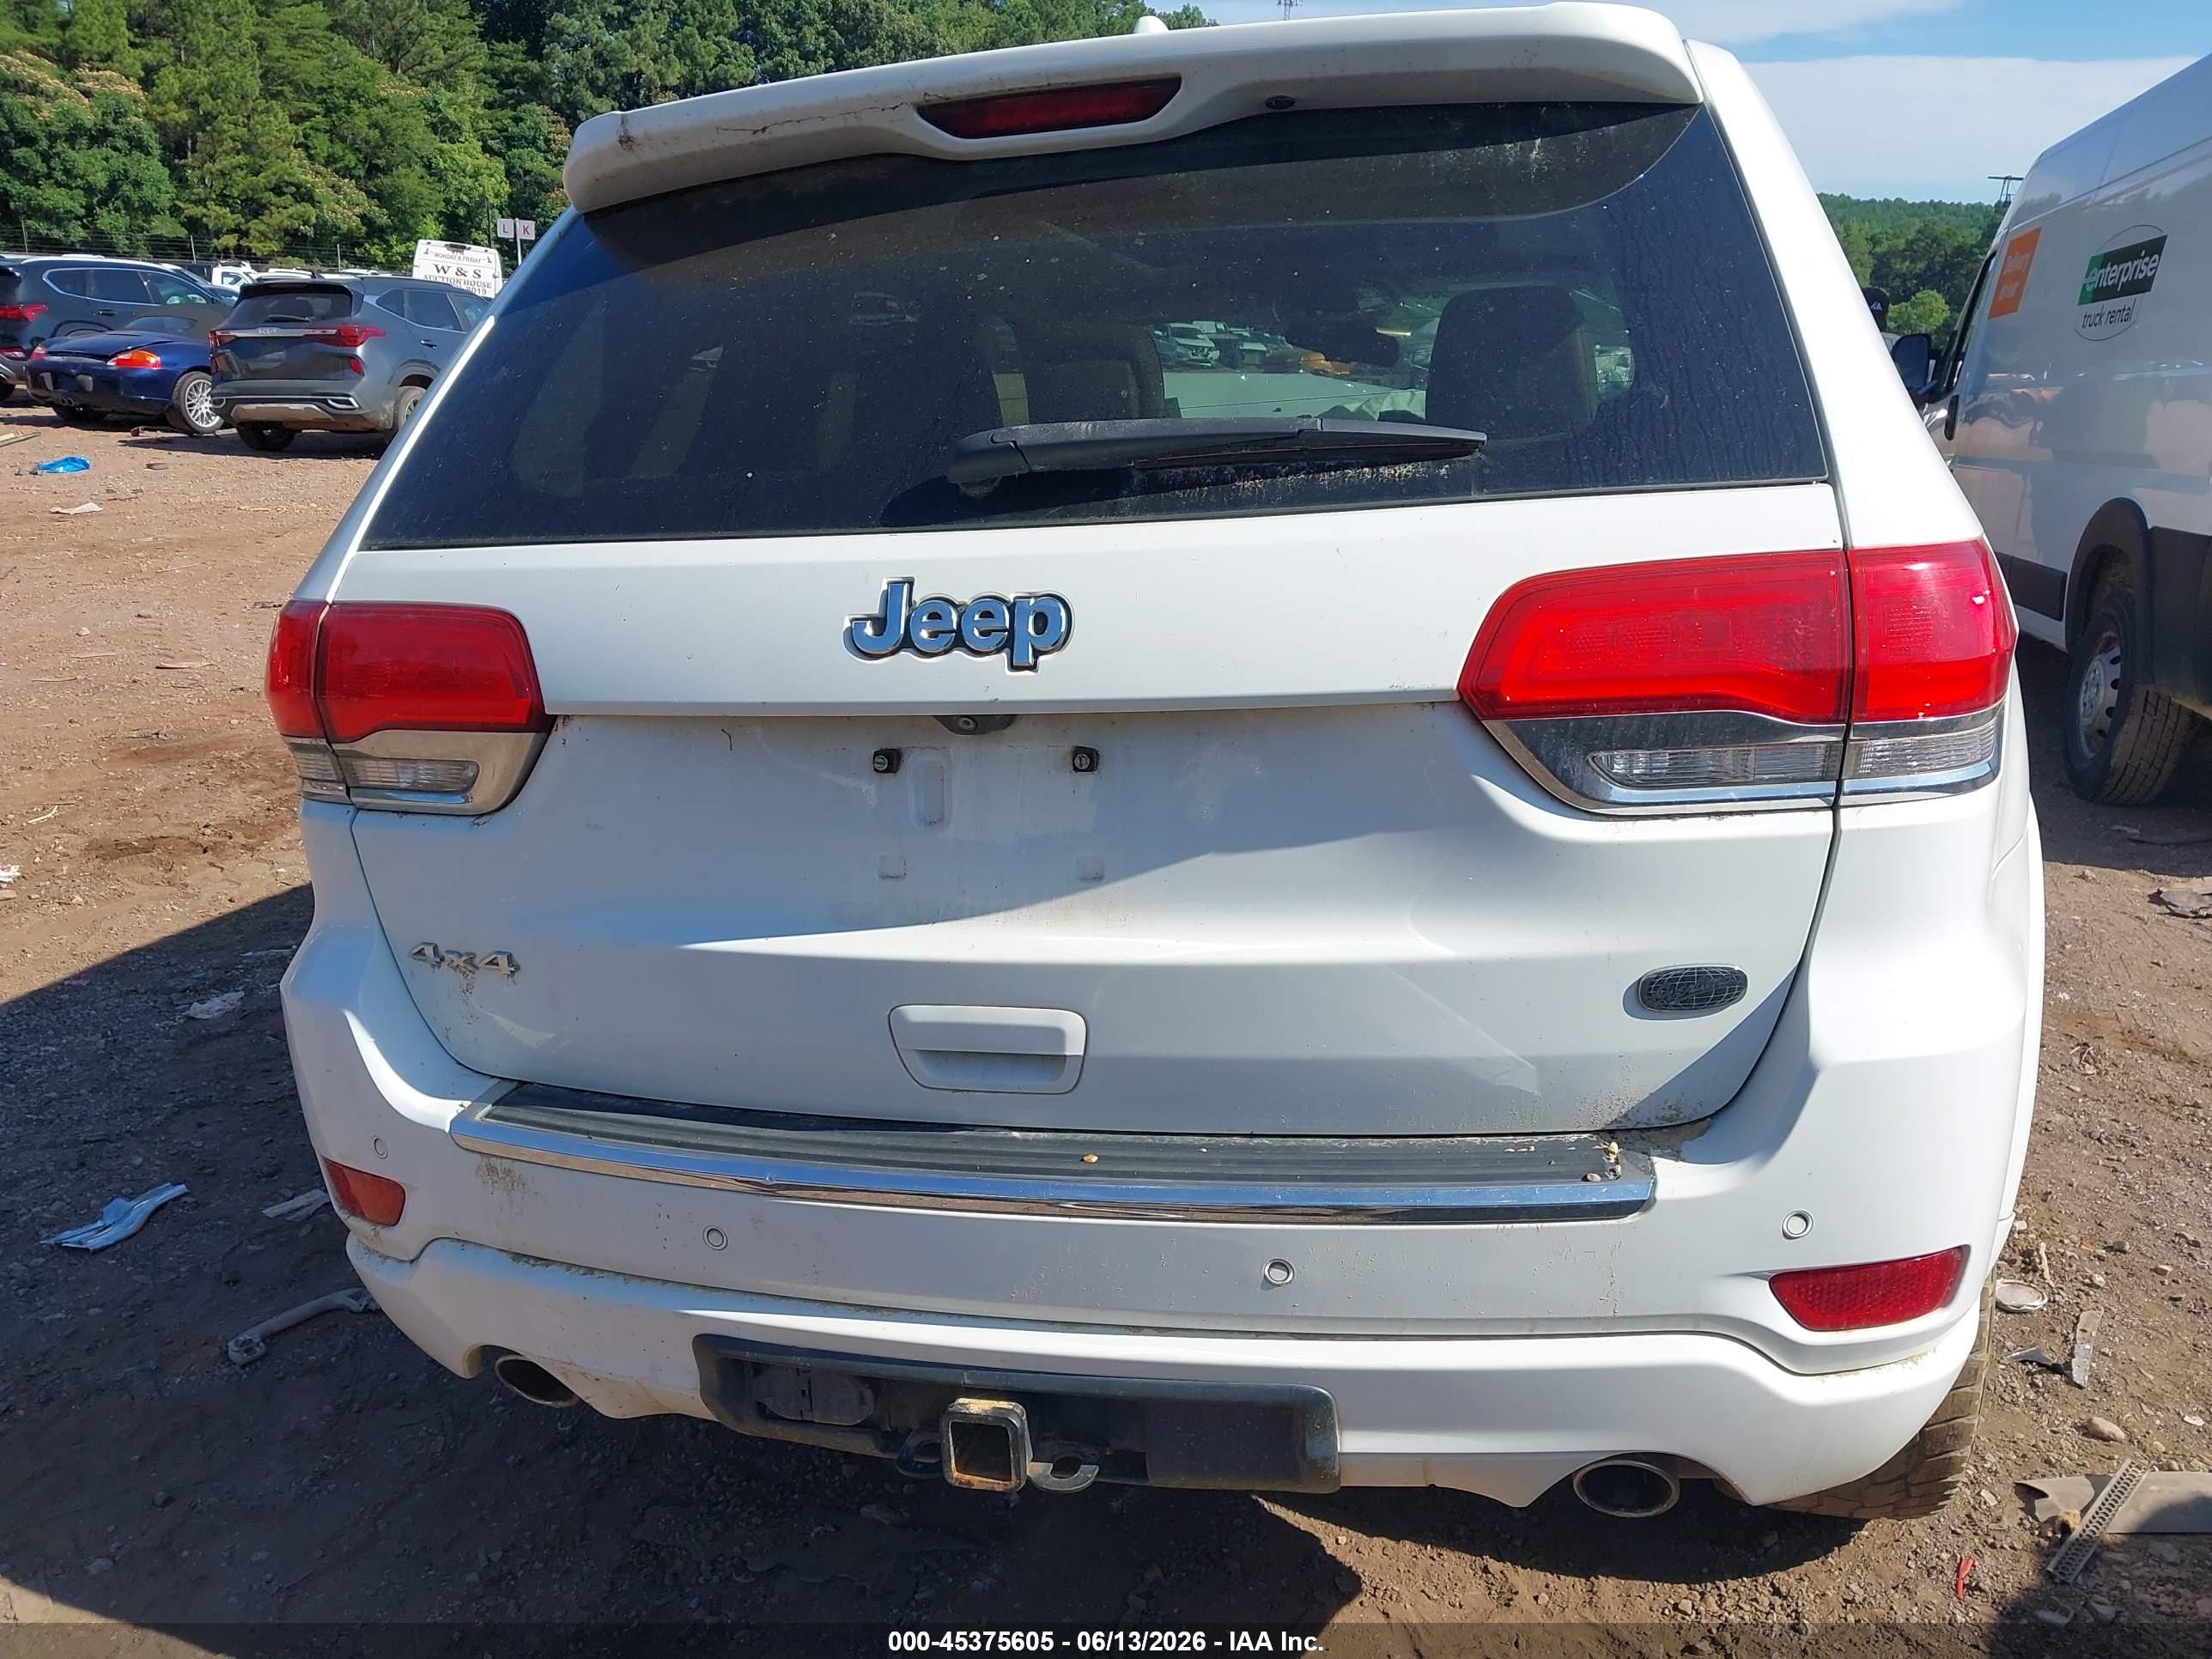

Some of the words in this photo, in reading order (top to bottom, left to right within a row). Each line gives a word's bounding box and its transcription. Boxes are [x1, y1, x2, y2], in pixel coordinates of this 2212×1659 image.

[501, 224, 509, 234] L
[522, 225, 531, 235] K
[434, 252, 456, 261] MONDAY
[433, 263, 452, 274] W
[455, 266, 467, 276] &
[472, 269, 481, 278] S
[2082, 250, 2160, 292] enterprise
[423, 274, 461, 284] AUCTION
[464, 279, 491, 289] HOUSE
[2082, 307, 2105, 329] truck
[2105, 298, 2136, 324] rental
[845, 577, 1073, 672] Jeep
